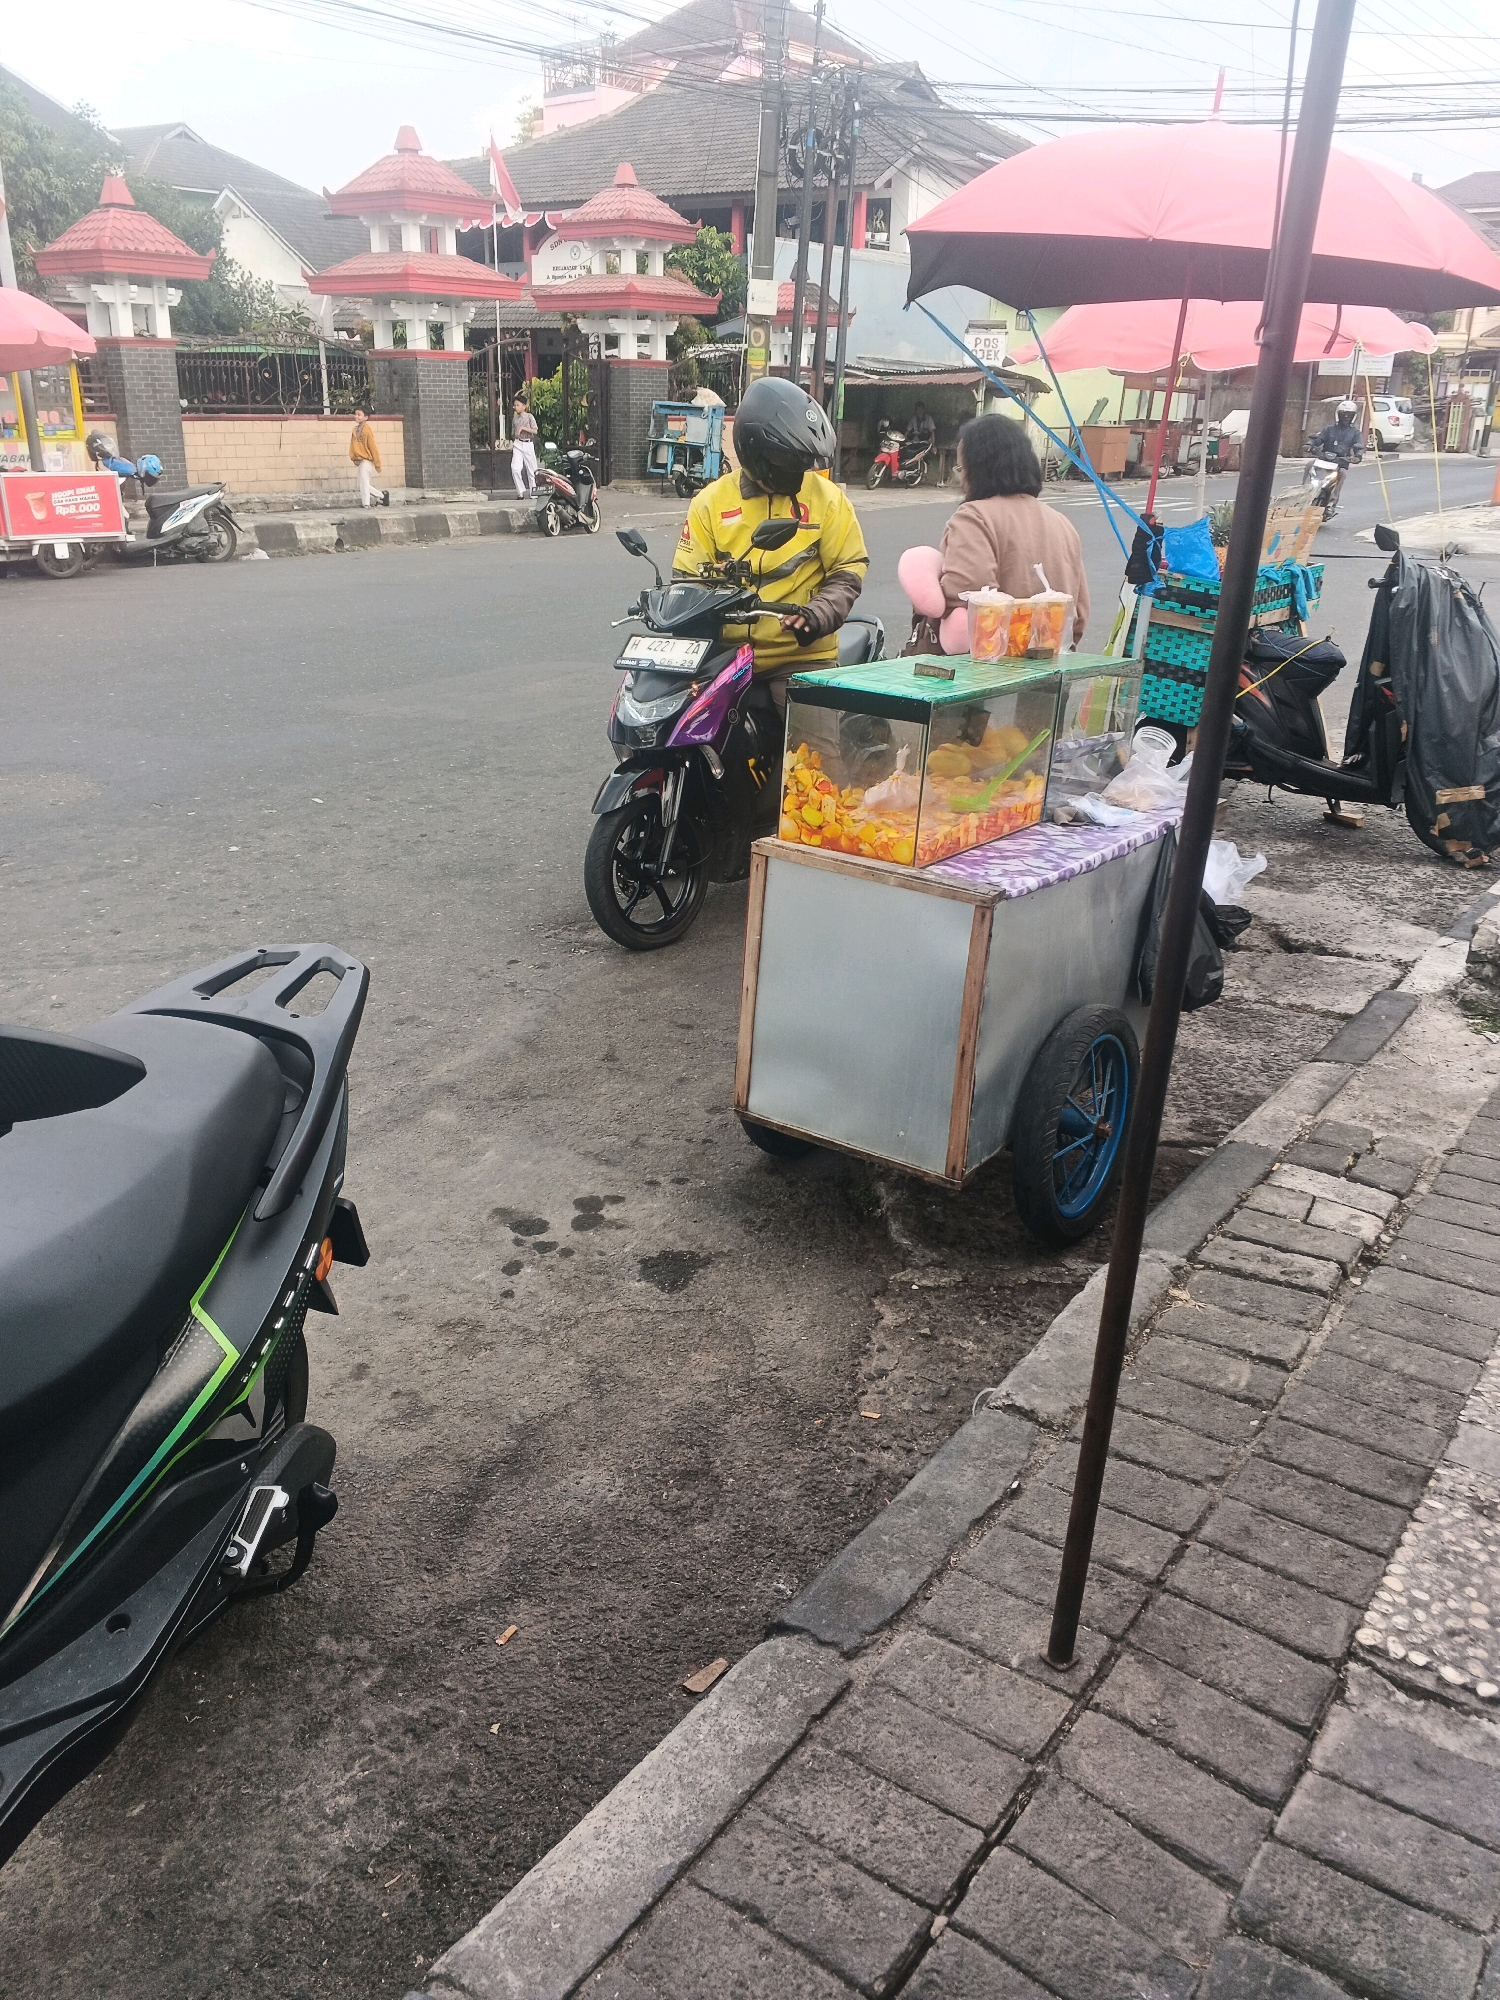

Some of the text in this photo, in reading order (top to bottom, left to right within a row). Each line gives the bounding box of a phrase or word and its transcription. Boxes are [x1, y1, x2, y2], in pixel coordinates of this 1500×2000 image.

[550, 239, 563, 250] SDN
[974, 337, 999, 349] POS
[52, 485, 96, 499] NGOPI ENAK
[55, 503, 101, 516] Rp8.000
[630, 639, 701, 655] H 4221 ZA
